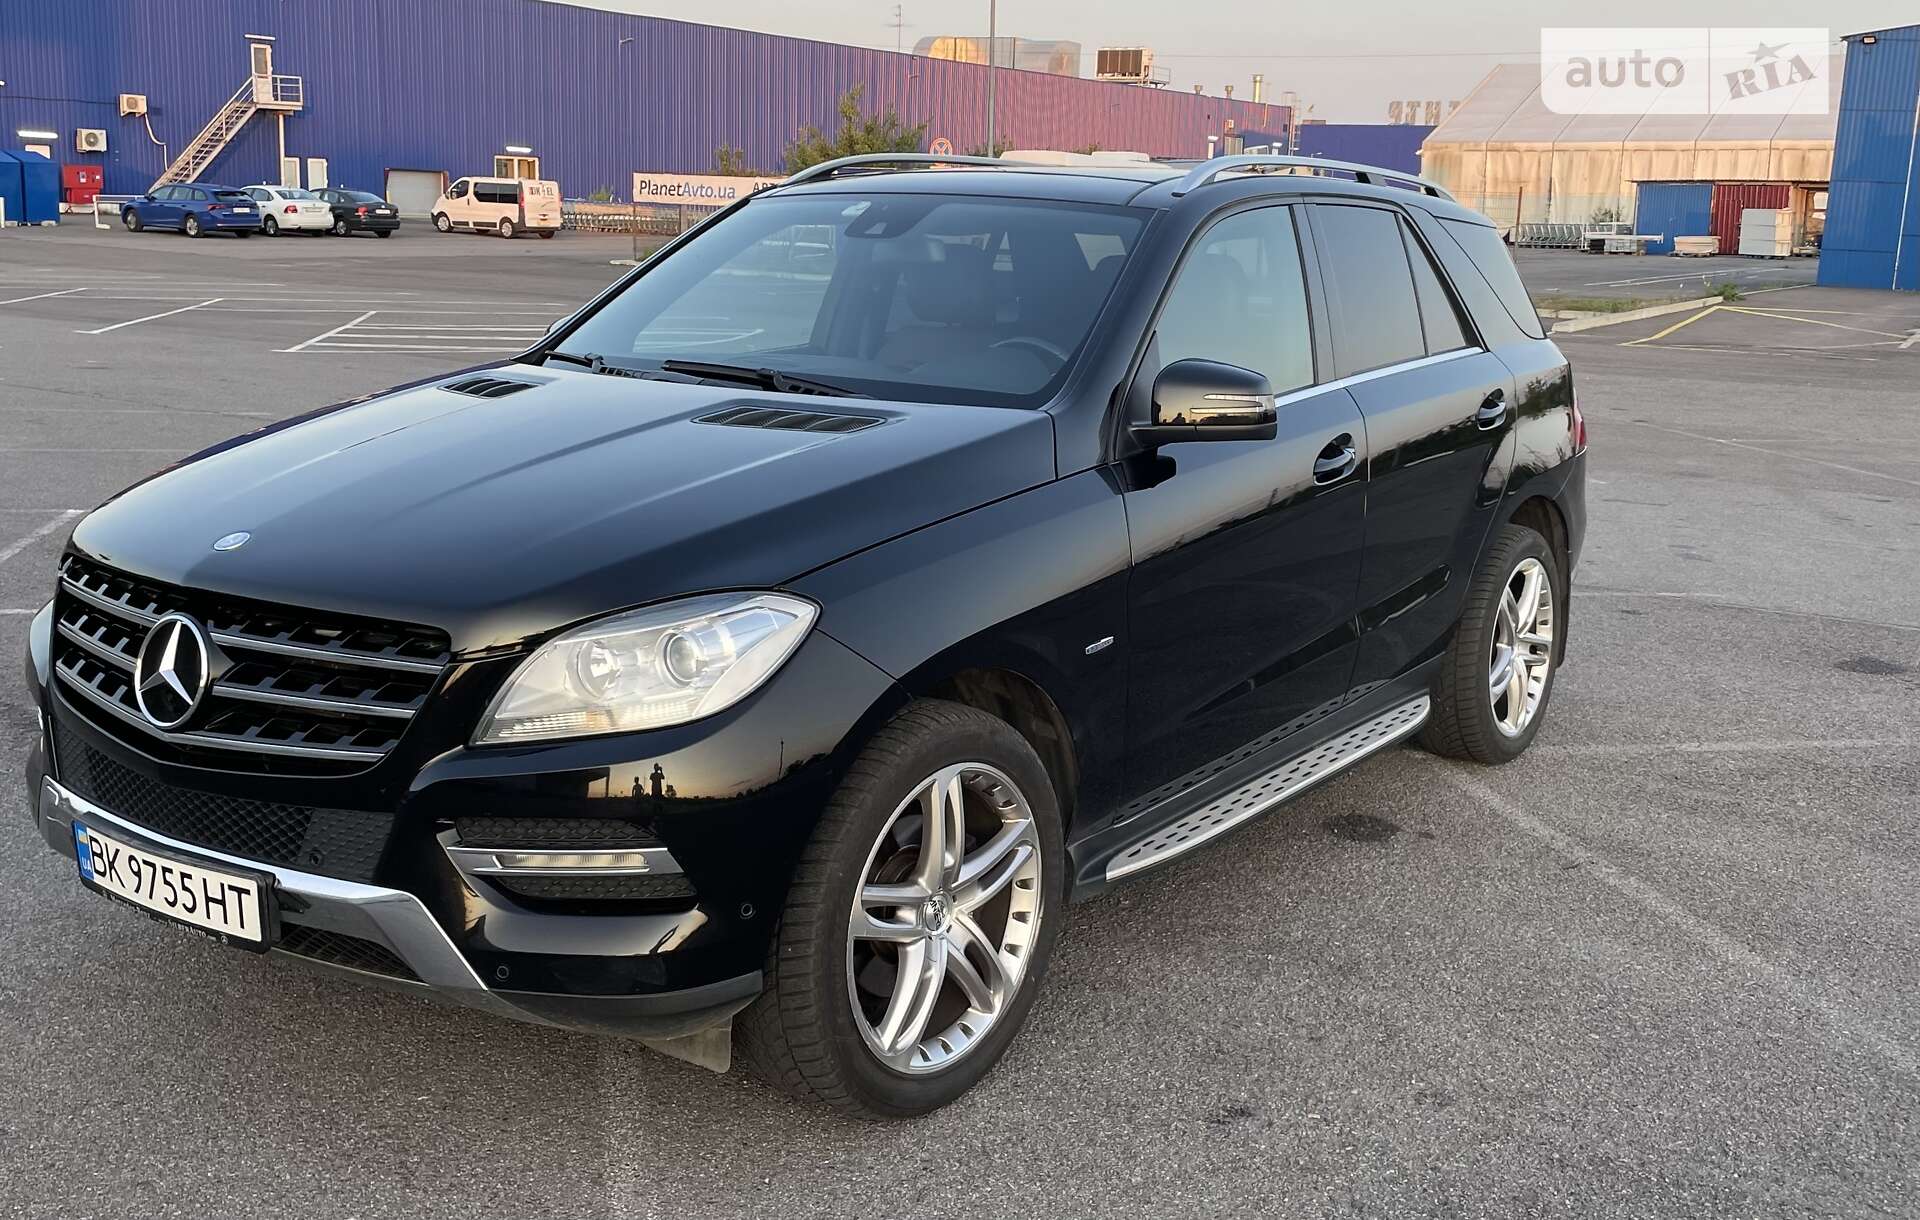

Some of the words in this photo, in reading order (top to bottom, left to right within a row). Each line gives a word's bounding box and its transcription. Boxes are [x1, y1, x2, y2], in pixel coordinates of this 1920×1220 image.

[639, 179, 736, 199] PlanetAvto.ua
[81, 856, 93, 873] UA
[88, 834, 126, 888] BK
[127, 854, 197, 914] 9755
[202, 877, 251, 930] HT
